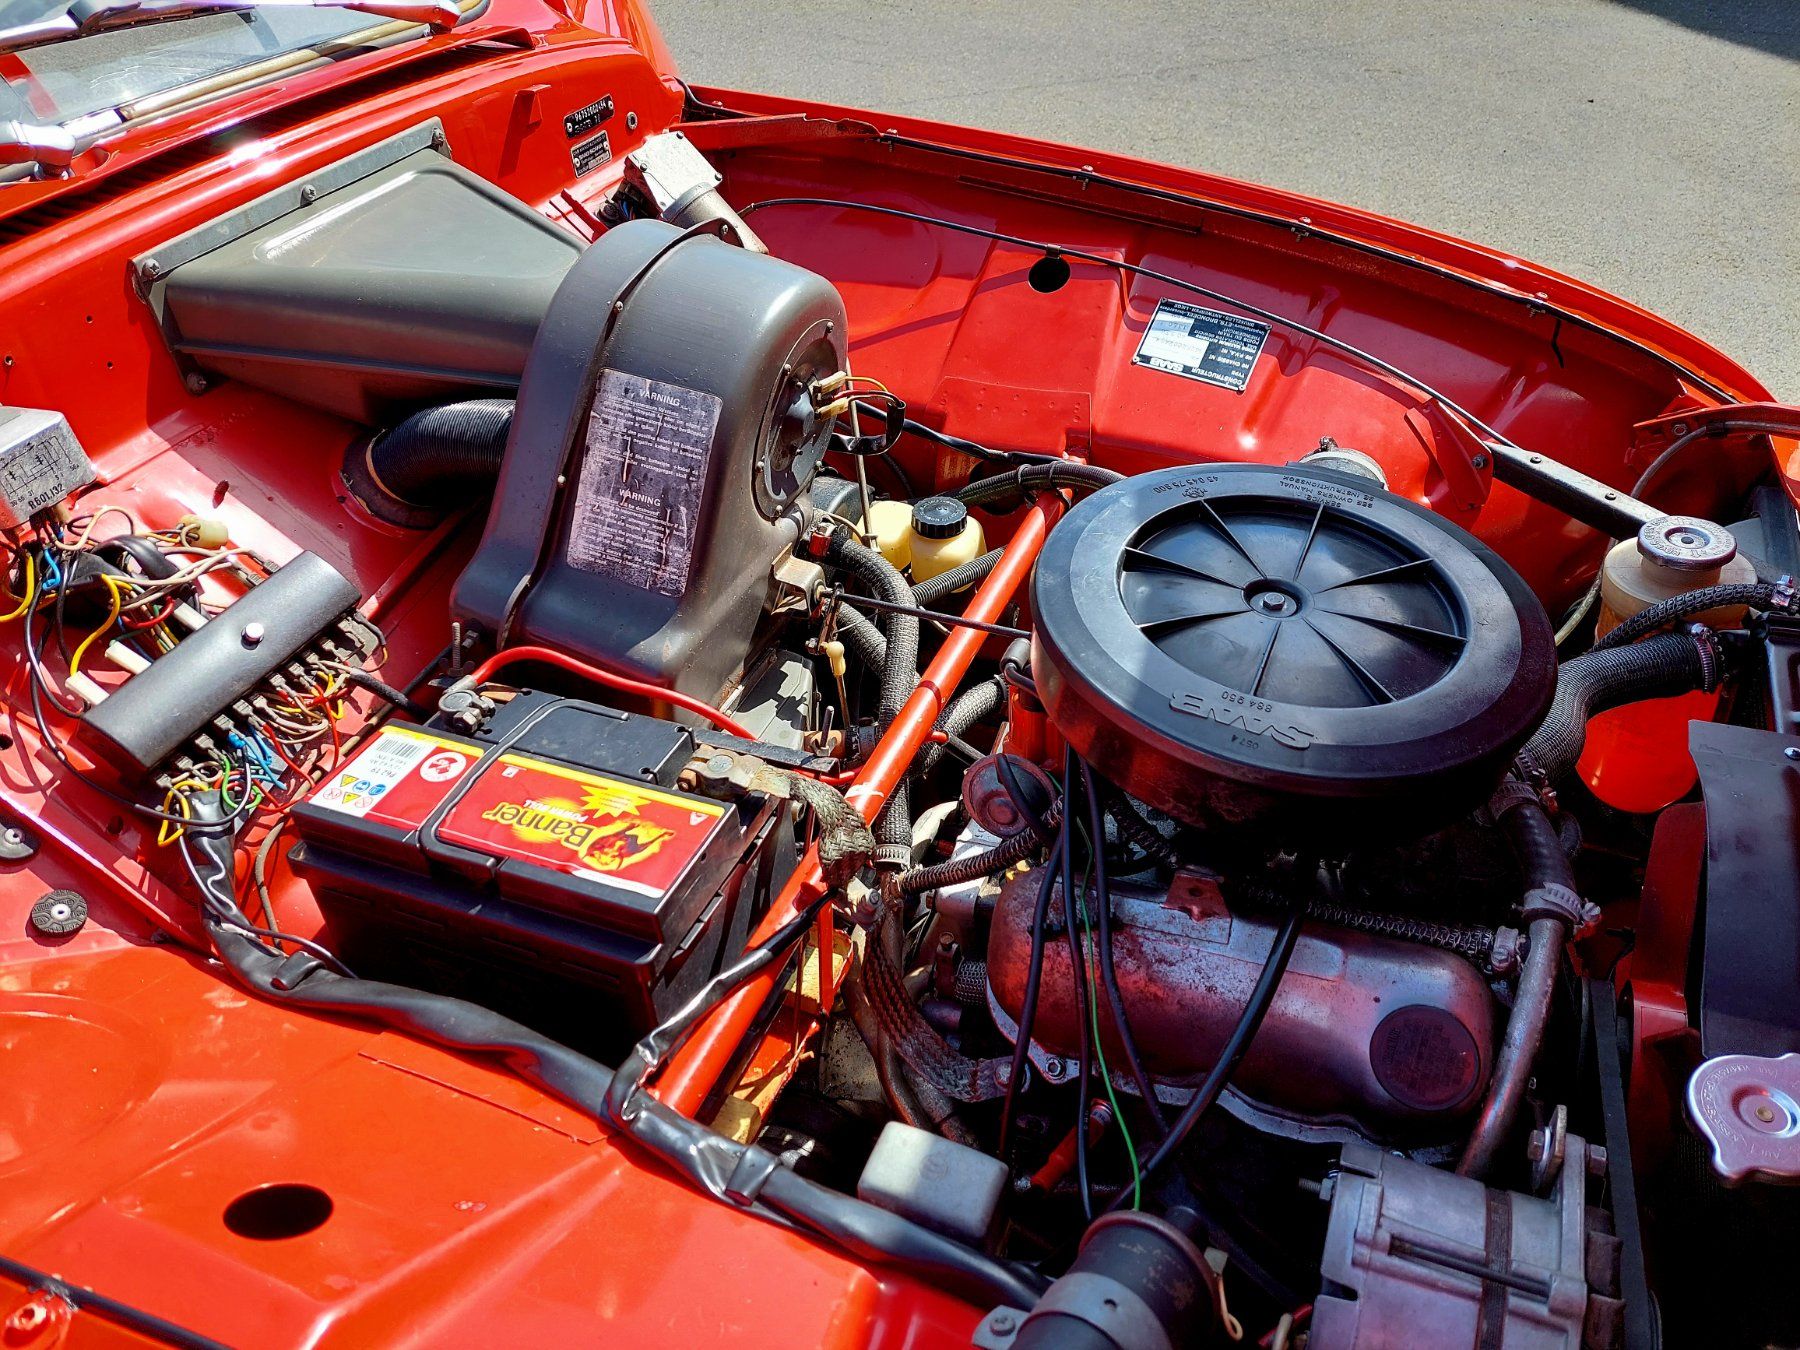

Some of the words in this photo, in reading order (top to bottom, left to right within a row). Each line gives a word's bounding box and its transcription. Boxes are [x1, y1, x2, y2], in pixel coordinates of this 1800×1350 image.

[1148, 356, 1185, 372] SAAB
[1190, 366, 1243, 385] CONSTRUCTEUR
[639, 390, 680, 406] VARNING
[1279, 480, 1314, 494] MANUAL
[618, 488, 661, 506] WARNING
[1317, 490, 1353, 504] OWNERS
[1356, 500, 1373, 508] SEE
[1168, 688, 1314, 750] SAAB
[478, 799, 596, 848] Banner
